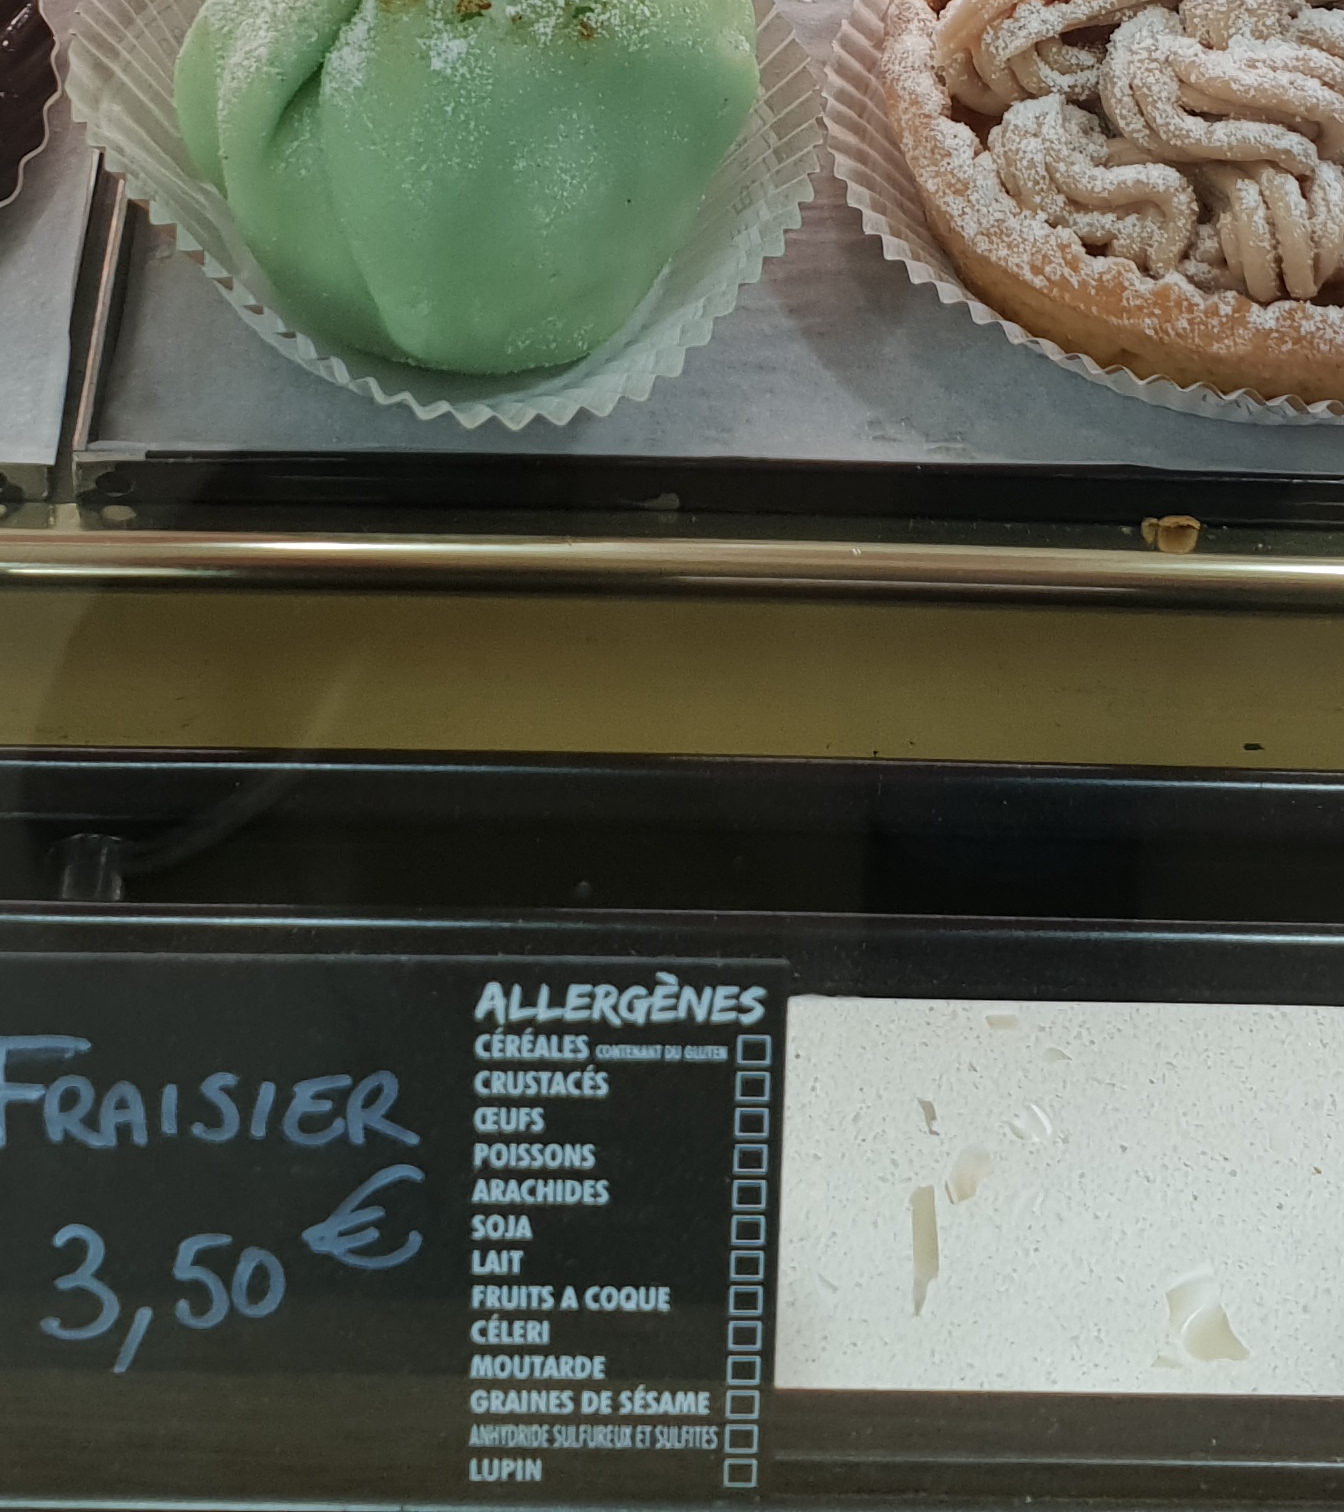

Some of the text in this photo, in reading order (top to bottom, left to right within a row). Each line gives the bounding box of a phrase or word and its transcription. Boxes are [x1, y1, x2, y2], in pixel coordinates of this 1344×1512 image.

[474, 971, 768, 1026] ALLERGÈNES
[473, 1027, 590, 1060] CÉRÉALES
[473, 1065, 610, 1098] CRUSTACÉS
[473, 1107, 545, 1134] ŒUFS
[473, 1143, 596, 1169] POISSONS
[471, 1179, 610, 1205] ARACHIDES
[471, 1214, 533, 1240] SOJA
[40, 1164, 424, 1373] 3,50 €
[471, 1250, 524, 1276] LAIT
[471, 1285, 671, 1312] FRUITS A COQUE
[470, 1314, 550, 1345] CÉLERI
[469, 1355, 606, 1380] MOUTARDE
[469, 1384, 711, 1415] GRAINES DE SÉSAME
[554, 1425, 633, 1449] SULFUREUX
[636, 1425, 651, 1449] ET
[468, 1458, 542, 1481] LUPIN
